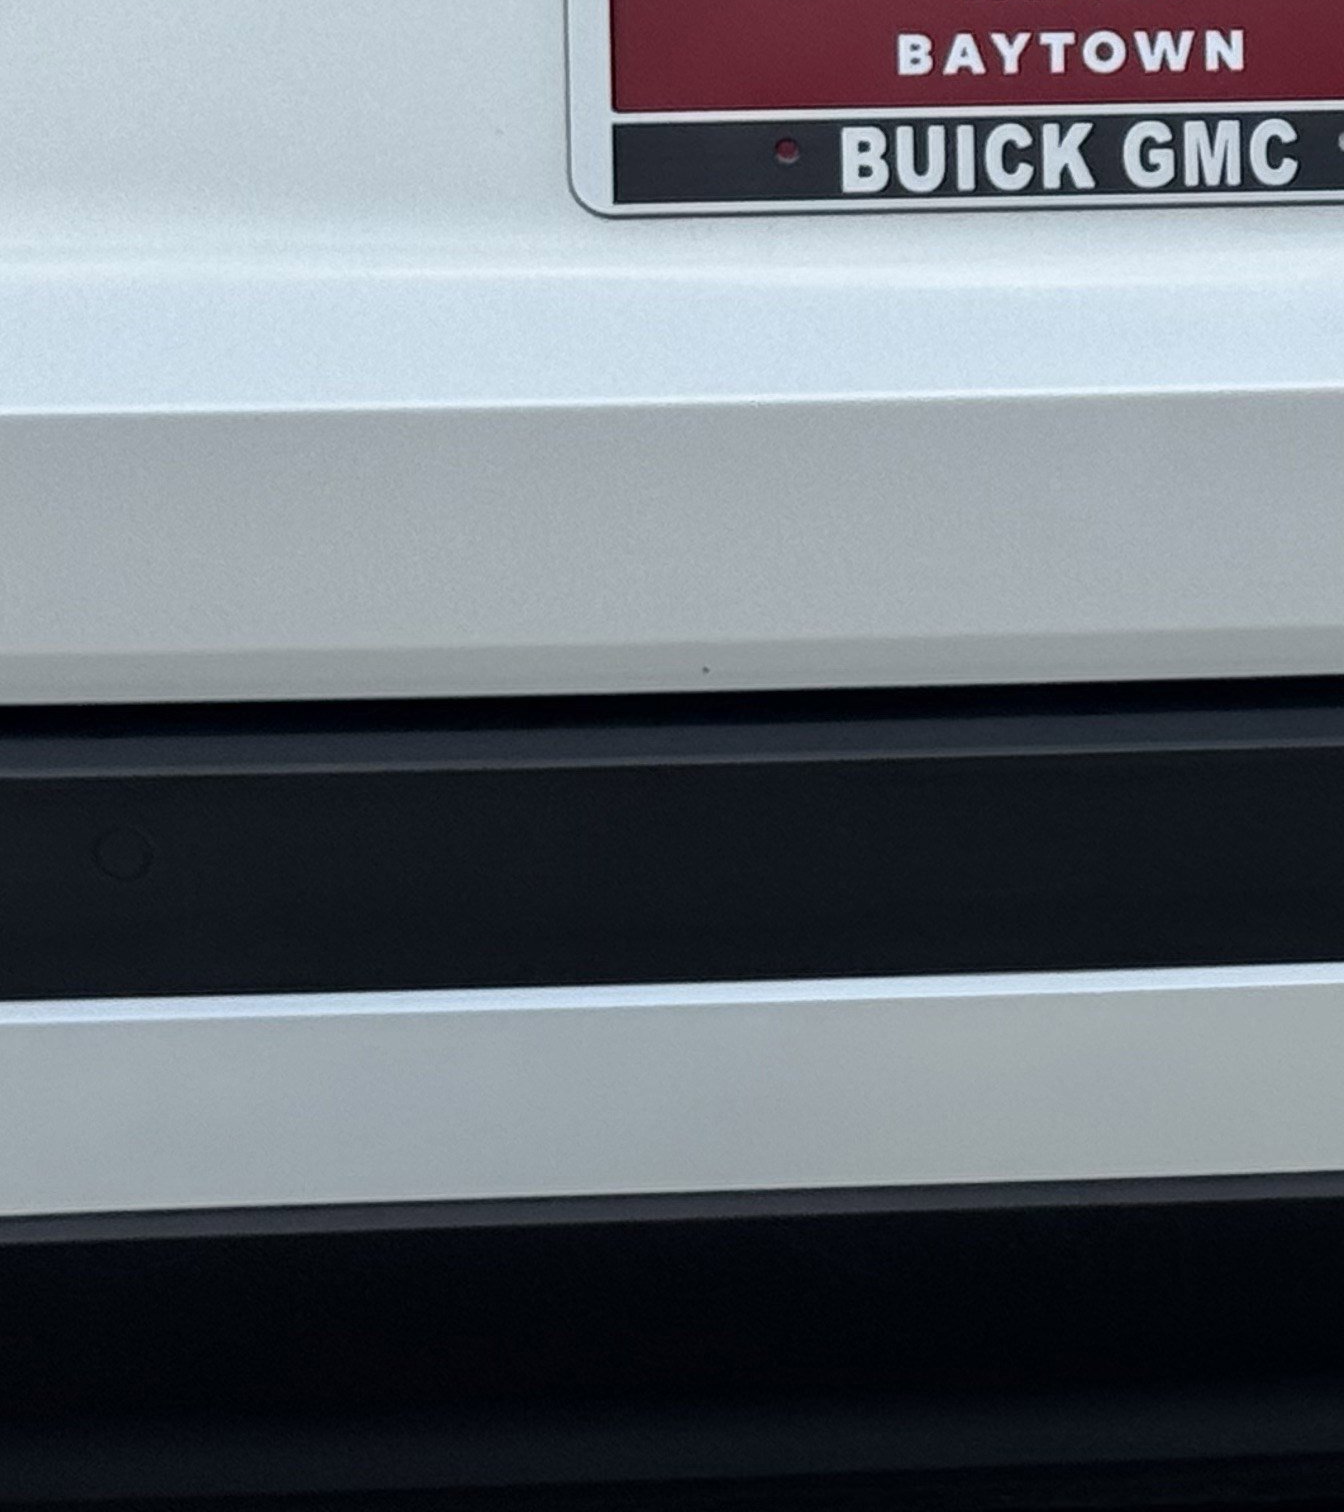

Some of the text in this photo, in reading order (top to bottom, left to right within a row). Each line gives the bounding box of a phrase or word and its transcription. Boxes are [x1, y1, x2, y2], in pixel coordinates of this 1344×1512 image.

[898, 30, 1245, 76] BAYTOWN
[840, 117, 1299, 194] BUICK GMC
